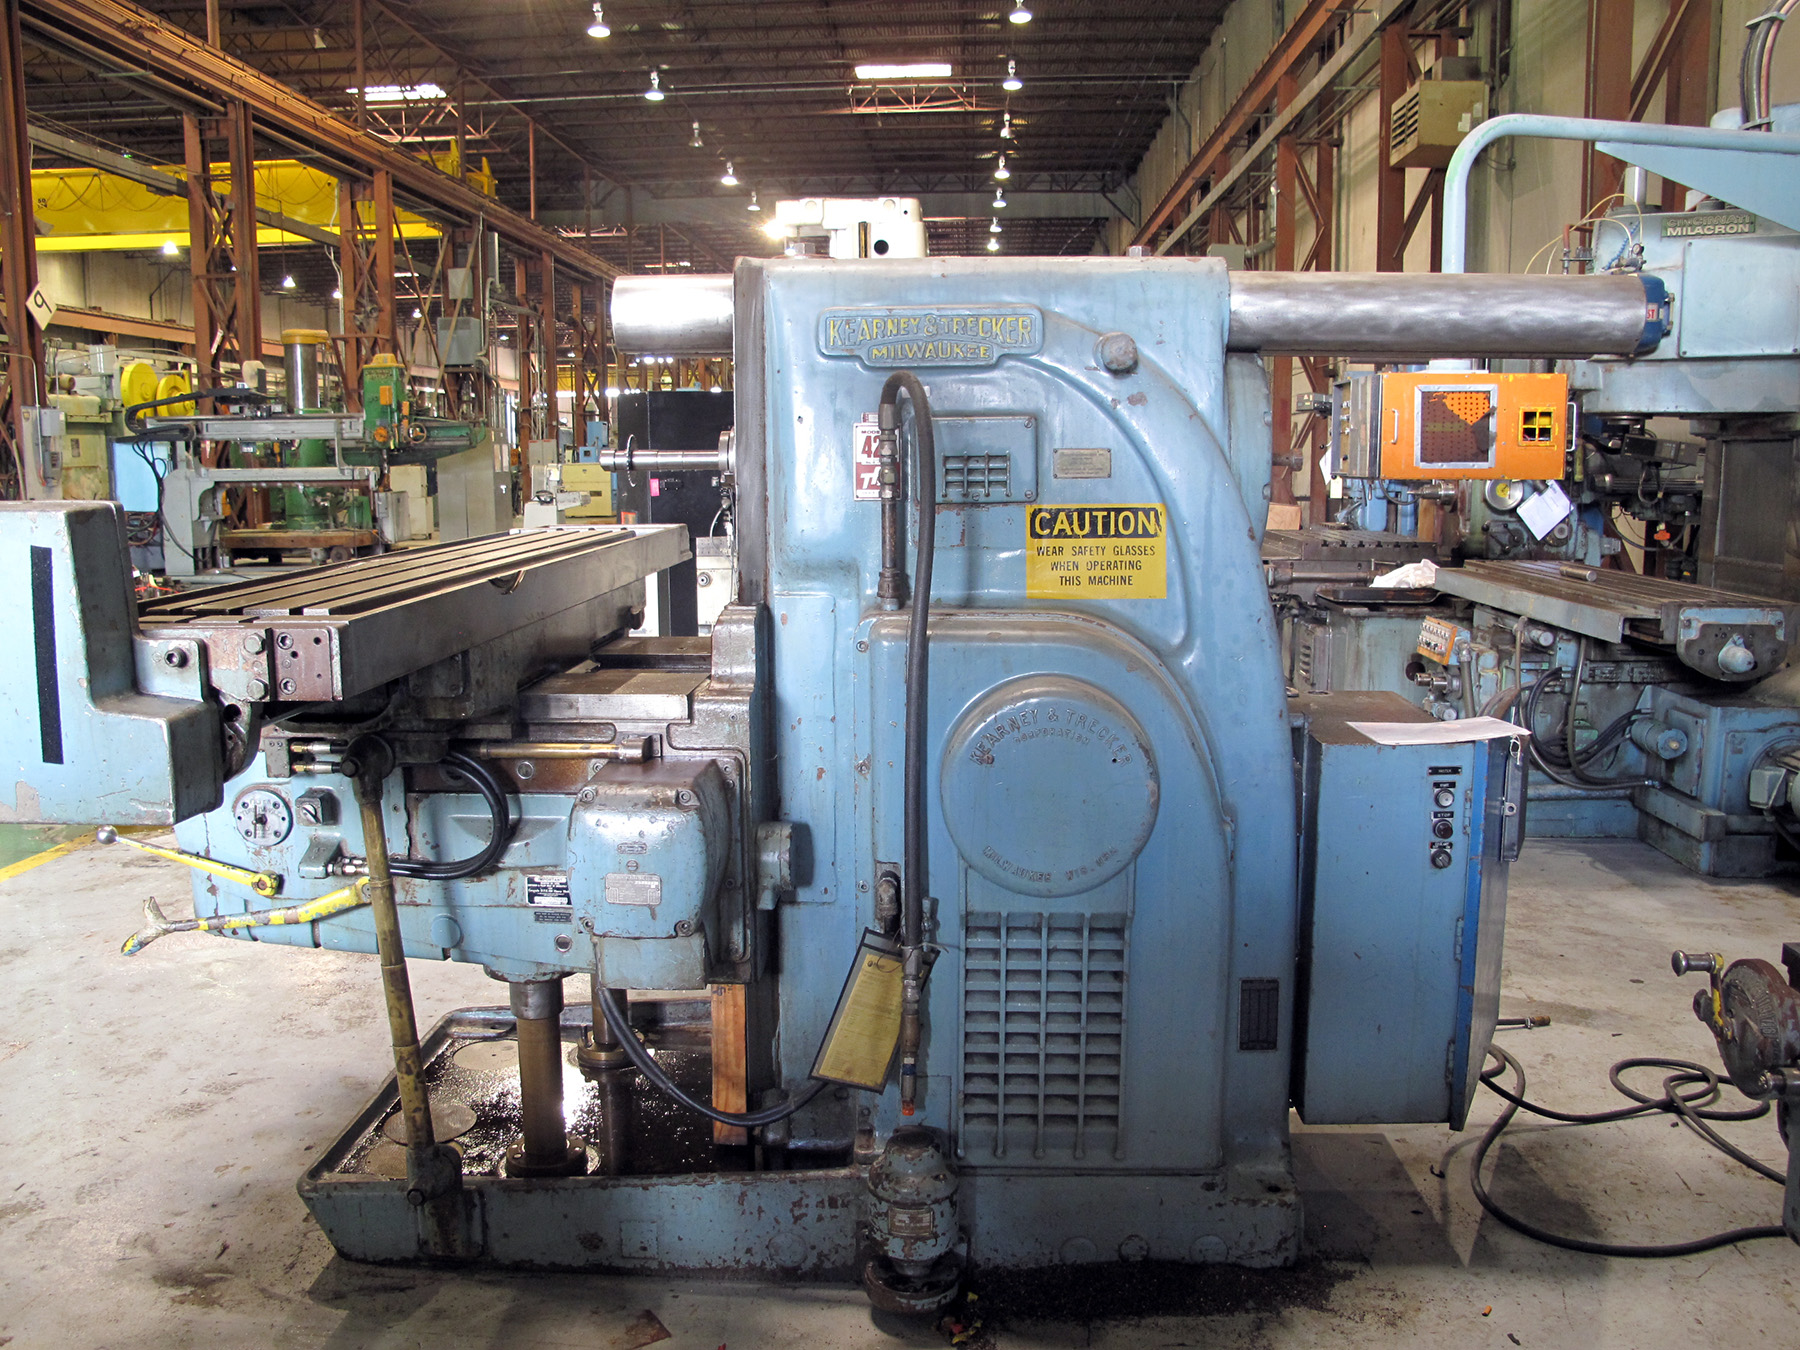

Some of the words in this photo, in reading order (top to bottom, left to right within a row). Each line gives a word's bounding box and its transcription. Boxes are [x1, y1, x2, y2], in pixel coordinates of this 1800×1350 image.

[1667, 215, 1750, 227] CINCINNATI
[1667, 224, 1750, 237] MILACRON
[829, 316, 920, 347] KEARNEY
[923, 315, 939, 336] &
[939, 315, 1034, 345] TRECKER
[871, 341, 991, 360] MILWAUKEE
[1034, 510, 1156, 536] CAUTION
[1036, 546, 1064, 557] WEAR
[1071, 546, 1106, 556] SAFETY
[1113, 545, 1156, 556] GLASSES
[1050, 561, 1079, 571] WHEN
[1086, 560, 1142, 571] OPERATING
[1059, 575, 1081, 586] THIS
[1088, 575, 1133, 586] MACHINE
[969, 709, 1039, 767] KEARNEY
[1046, 708, 1059, 722] &
[1066, 709, 1134, 767] TRECKER
